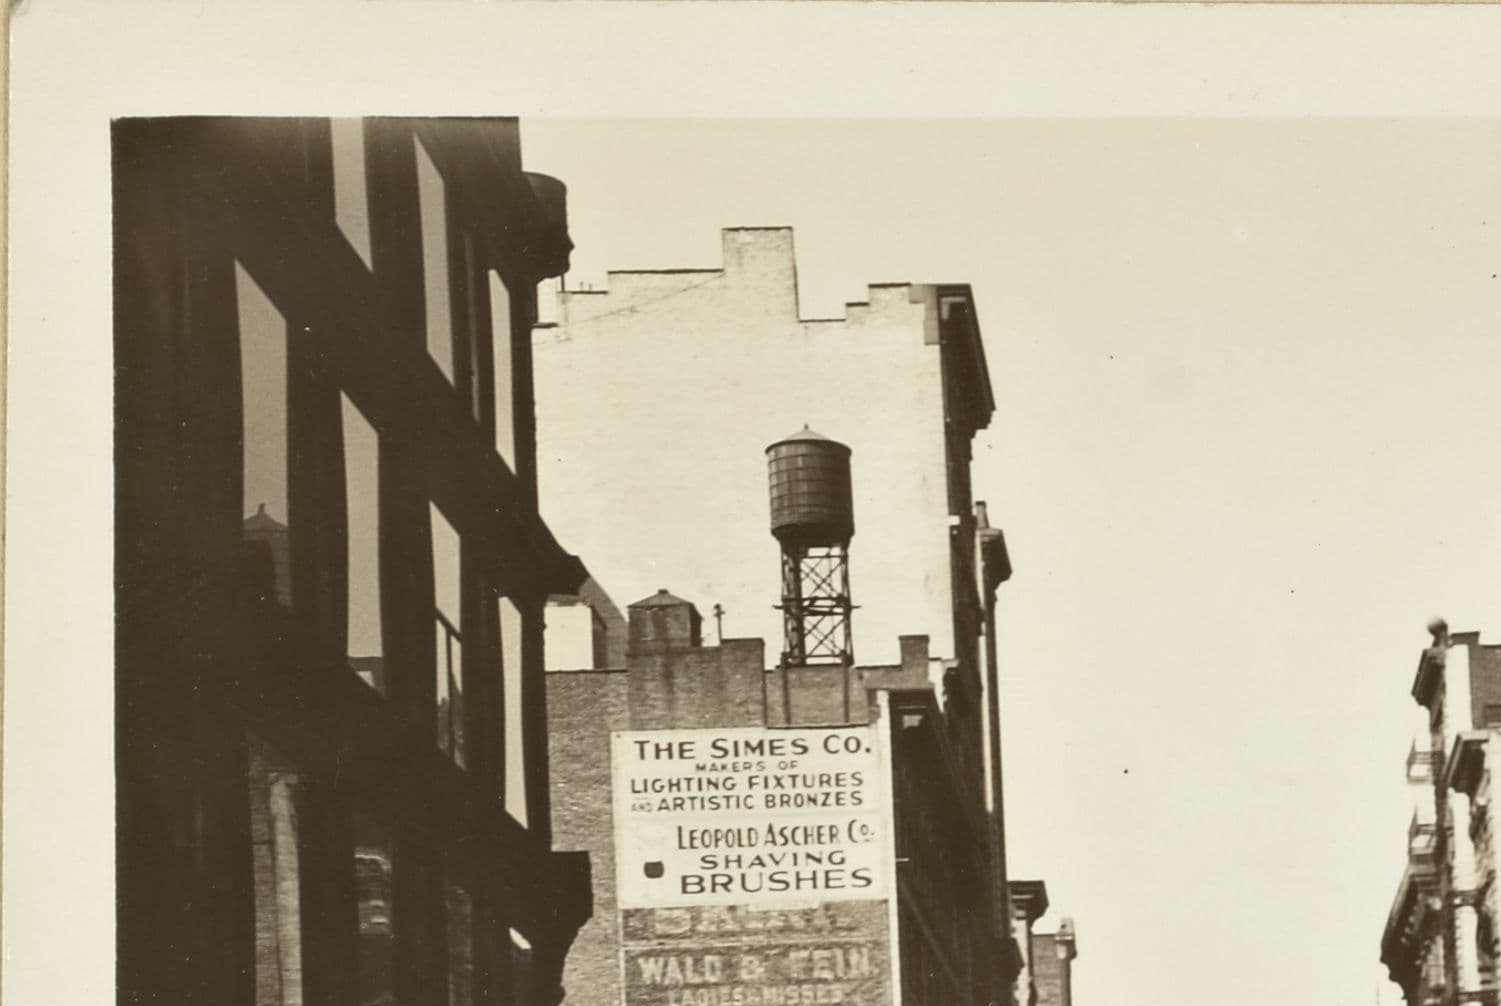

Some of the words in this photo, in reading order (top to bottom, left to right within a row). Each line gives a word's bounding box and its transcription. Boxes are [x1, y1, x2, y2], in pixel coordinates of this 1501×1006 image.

[633, 739, 696, 761] THE
[711, 736, 809, 759] SIMES
[695, 760, 766, 773] MAKERS
[777, 760, 799, 771] OF
[631, 776, 737, 794] LIGHTING
[748, 771, 864, 791] FIXTURES
[657, 794, 755, 812] ARTISTIC
[765, 790, 864, 809] BRONZES
[677, 825, 759, 850] LEOPOLD
[764, 823, 841, 847] ASCHER
[700, 850, 847, 871] SHAVING
[681, 868, 873, 895] BRUSHES
[637, 954, 723, 986] WALD
[740, 954, 766, 981] &
